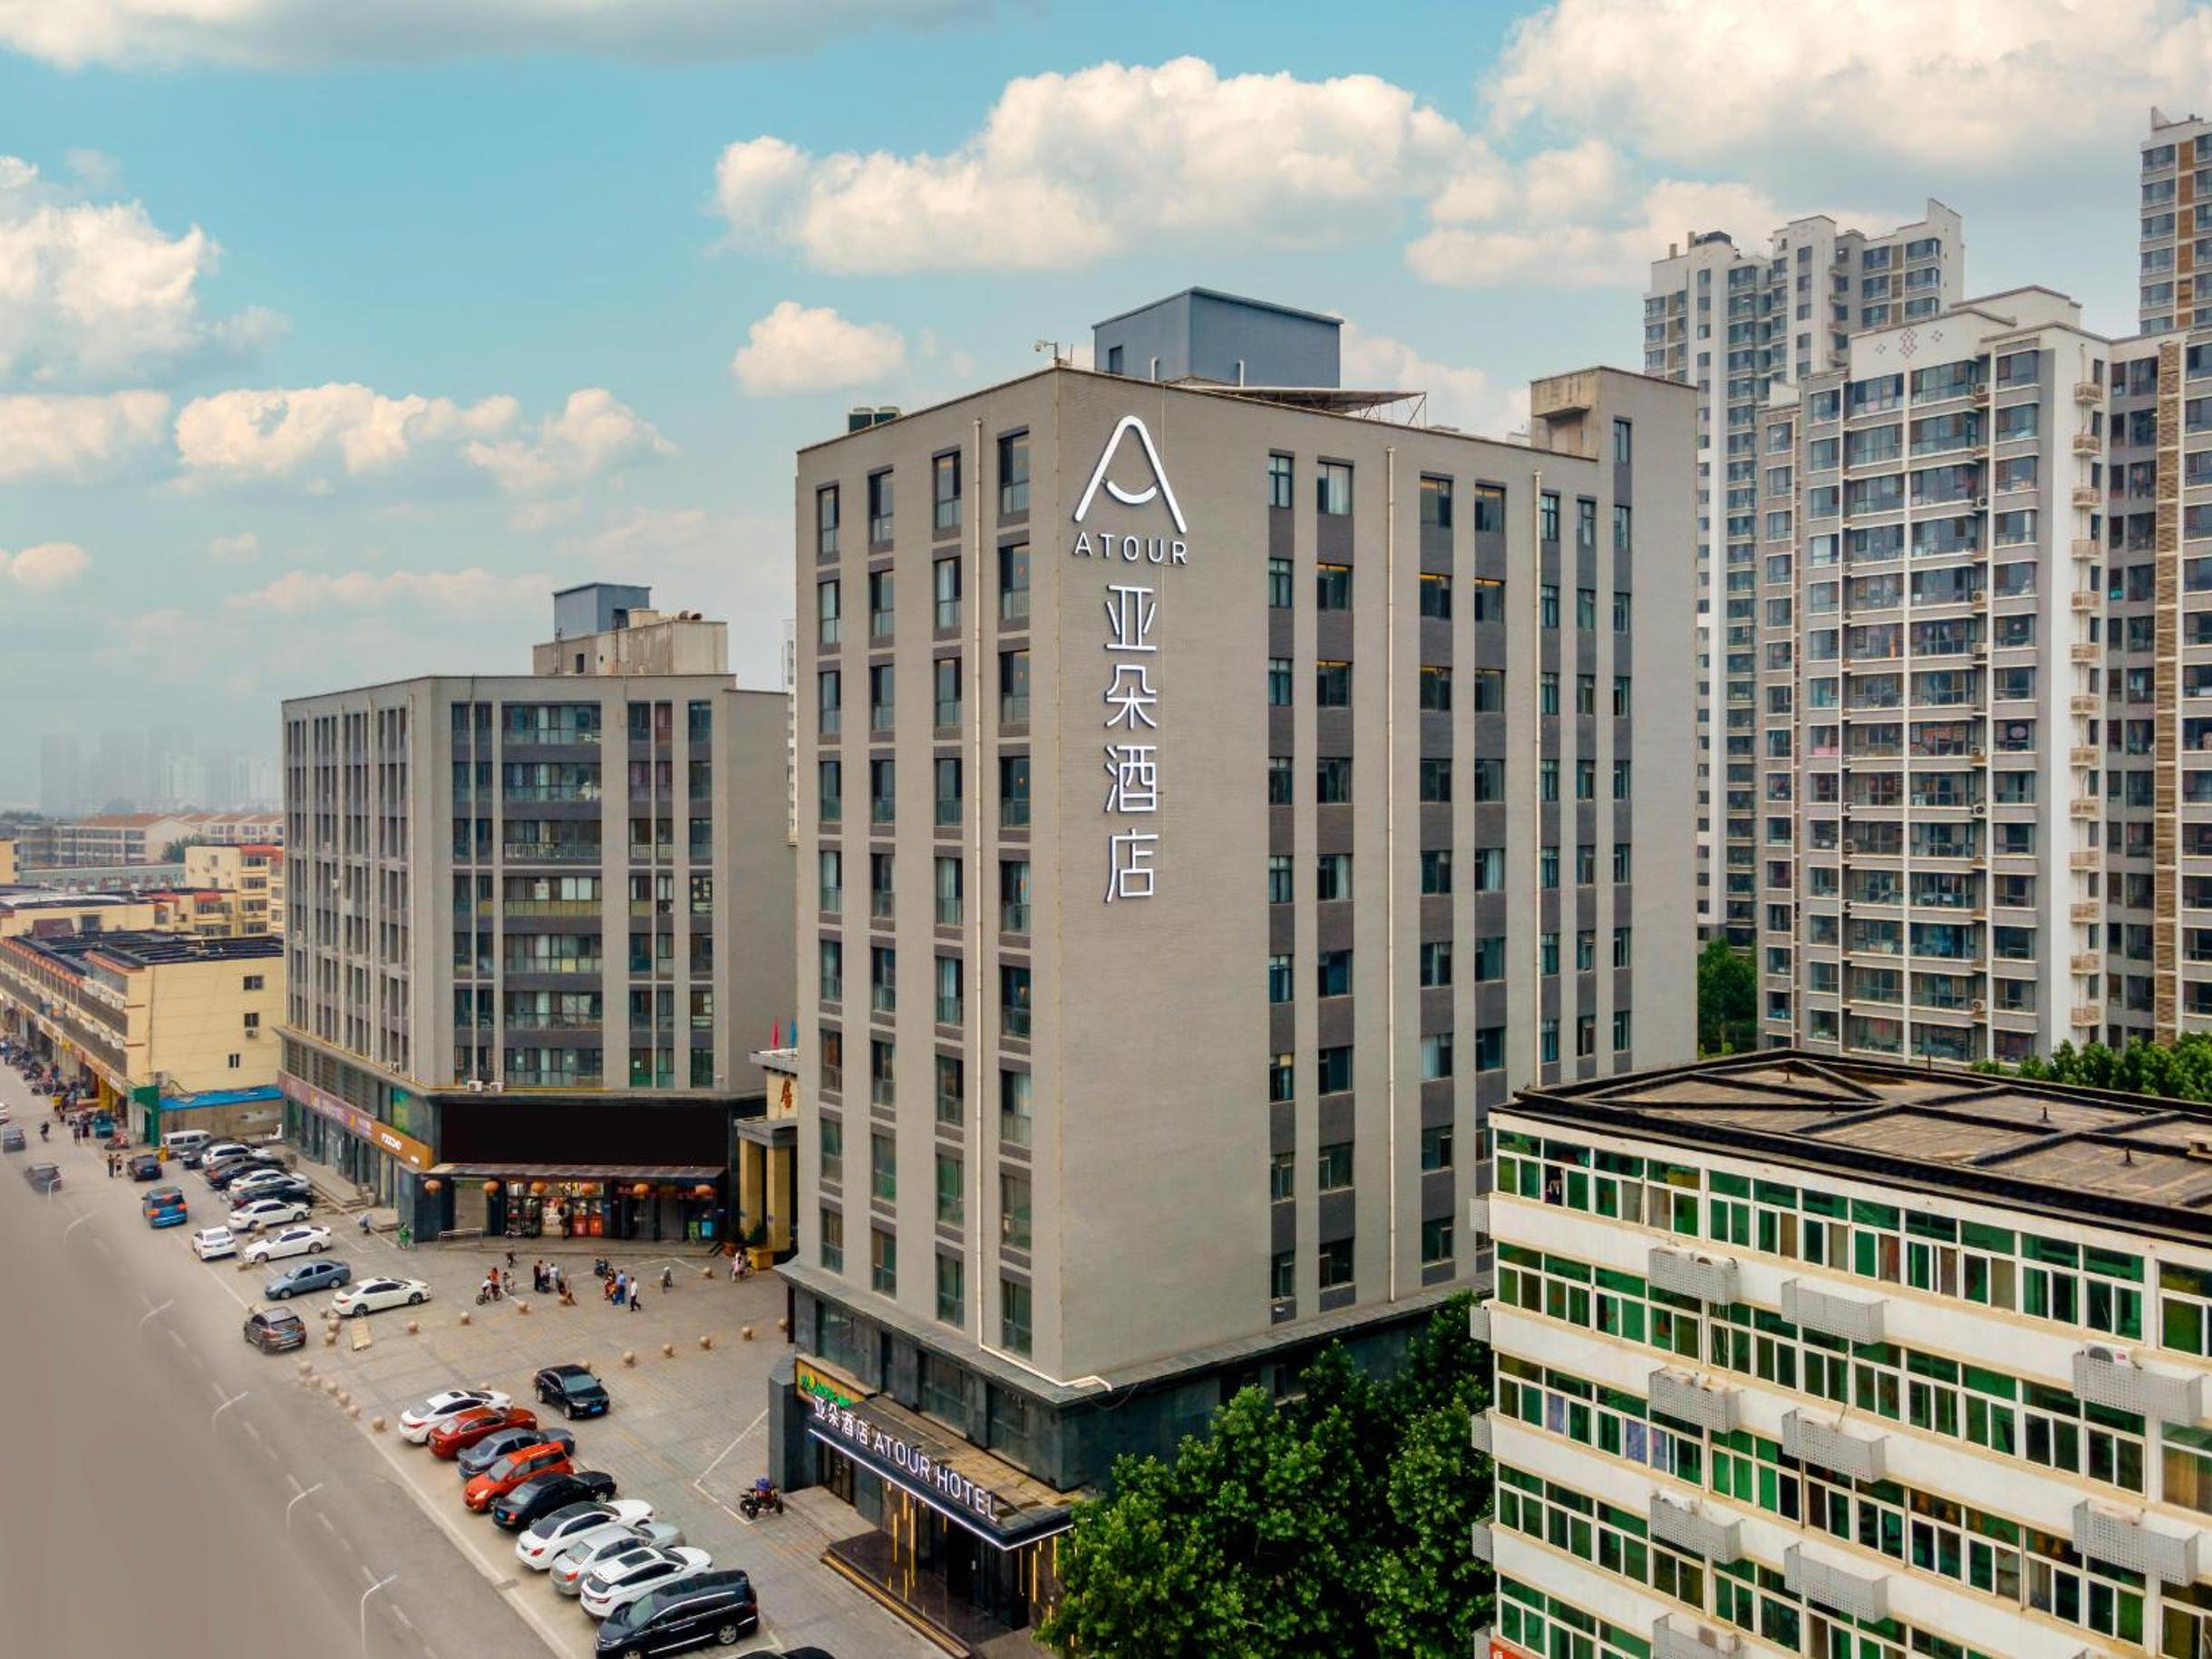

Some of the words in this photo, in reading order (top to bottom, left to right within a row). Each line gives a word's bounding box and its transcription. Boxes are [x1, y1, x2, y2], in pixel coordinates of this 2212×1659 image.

[1073, 530, 1188, 566] ATOUR
[1104, 584, 1159, 903] 亚朵酒店
[814, 1394, 869, 1446] 亚朵酒店
[873, 1431, 931, 1482] ATOUR
[936, 1465, 998, 1522] HOTEL
